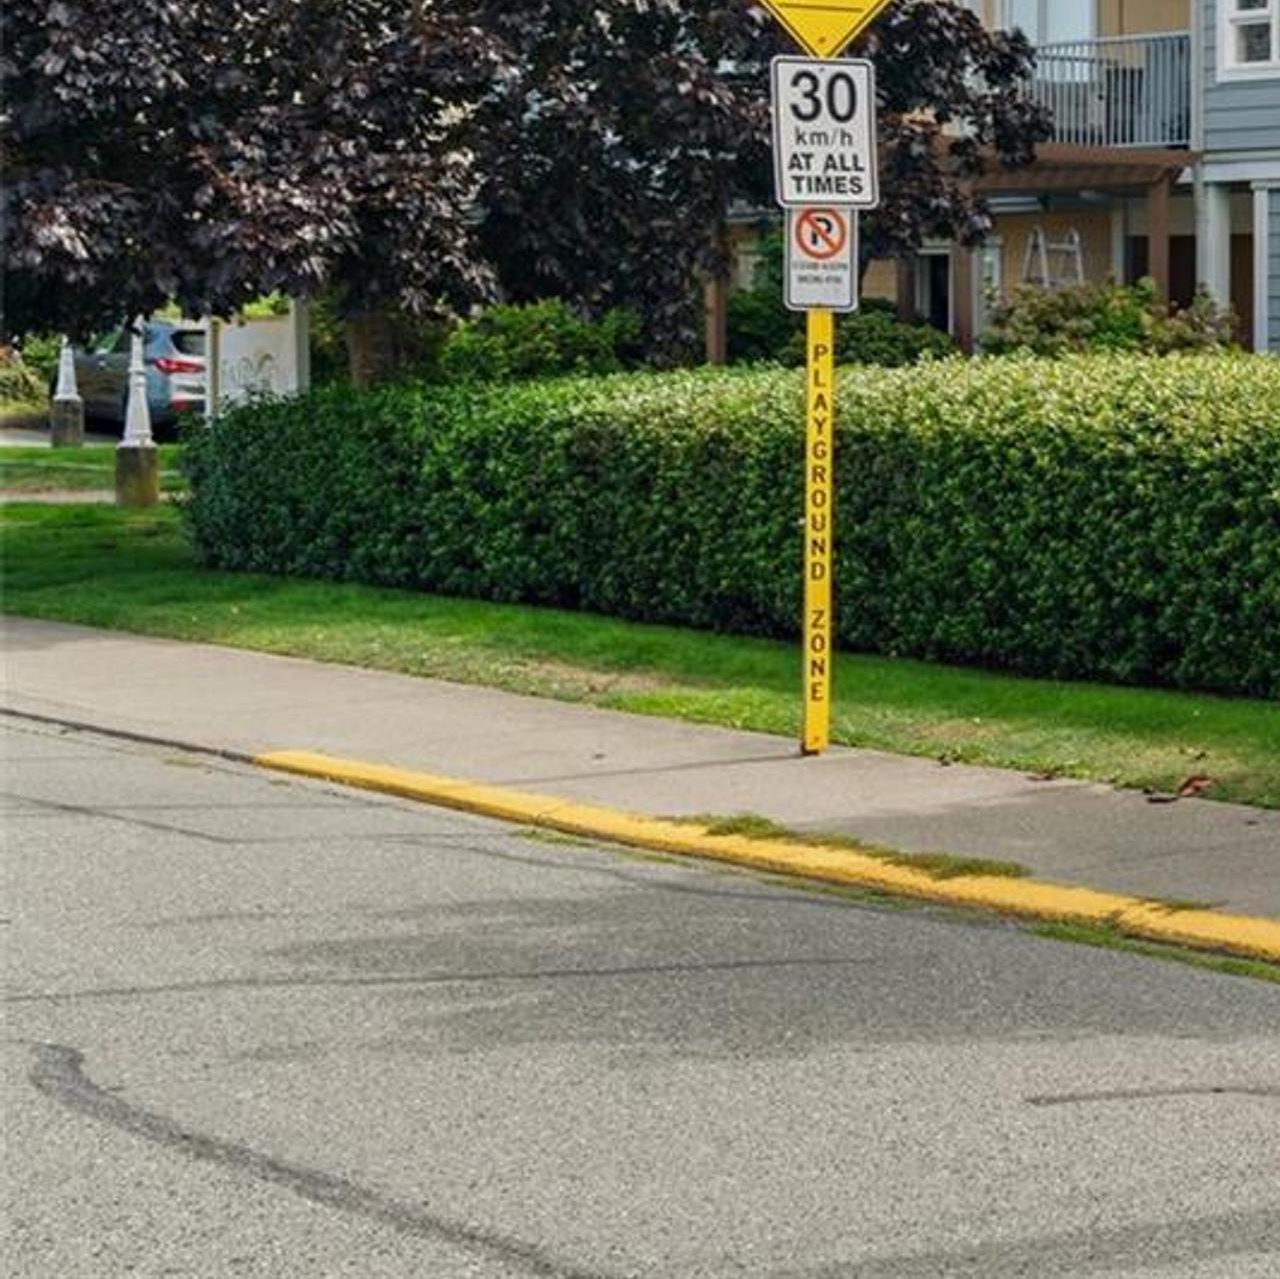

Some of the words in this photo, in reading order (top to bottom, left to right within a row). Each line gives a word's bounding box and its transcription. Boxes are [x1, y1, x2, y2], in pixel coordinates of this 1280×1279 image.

[790, 71, 858, 124] 30
[794, 127, 854, 147] km/h
[787, 153, 815, 172] AT
[823, 153, 865, 173] ALL
[791, 174, 864, 196] TIMES
[811, 343, 829, 581] PLAYGROUND
[811, 609, 827, 702] ZONE
